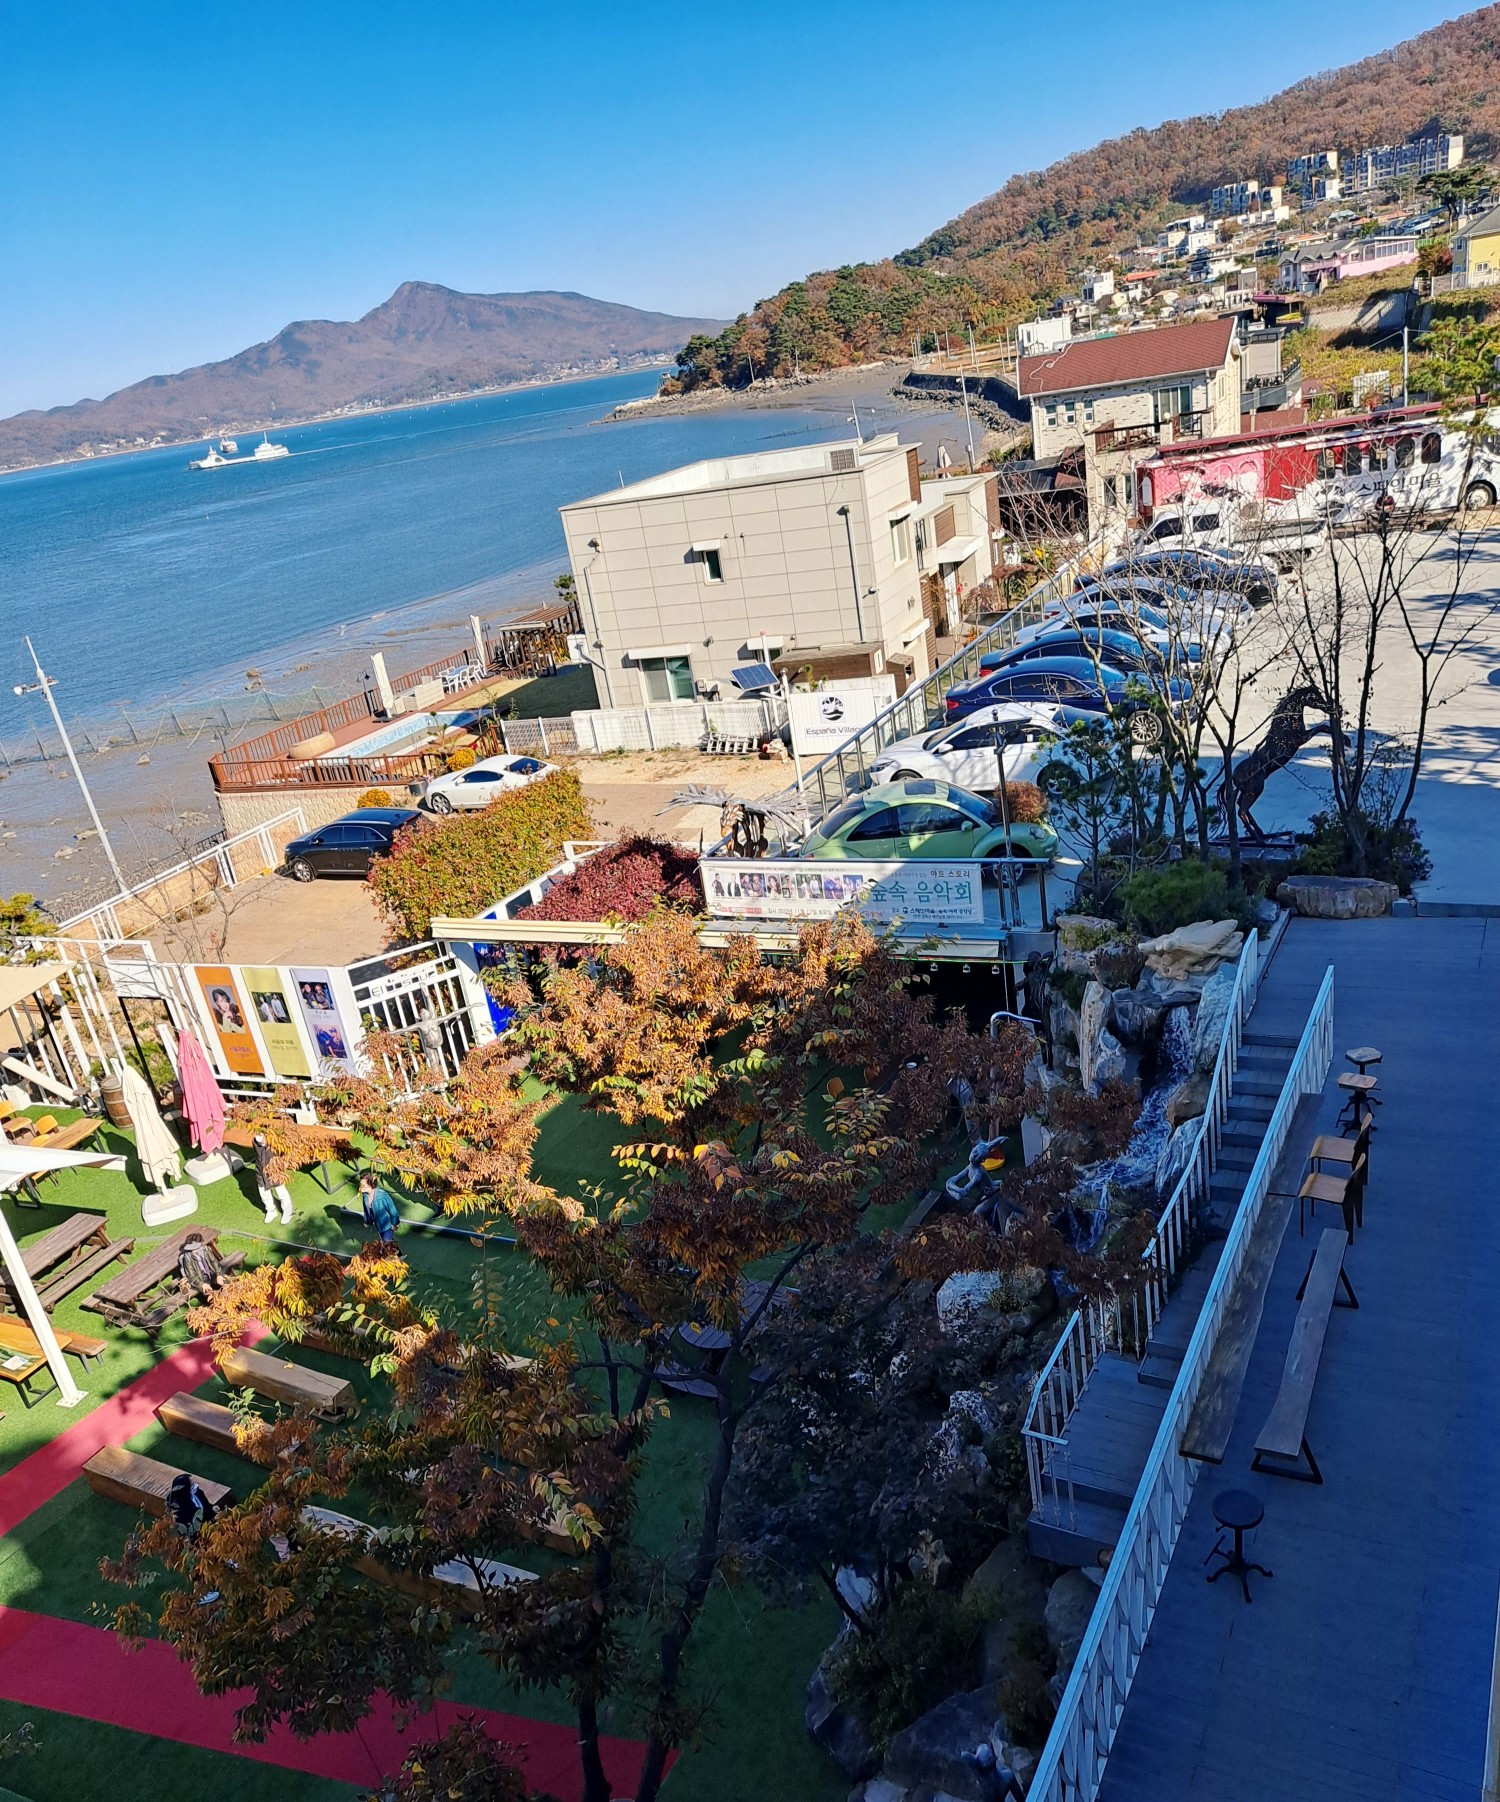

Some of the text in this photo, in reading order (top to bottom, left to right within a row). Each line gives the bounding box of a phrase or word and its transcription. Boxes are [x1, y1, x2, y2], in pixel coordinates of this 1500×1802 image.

[838, 726, 861, 734] Villag
[930, 869, 945, 878] 아트
[948, 869, 971, 878] 스토리
[871, 880, 973, 904] 숲속 음악회
